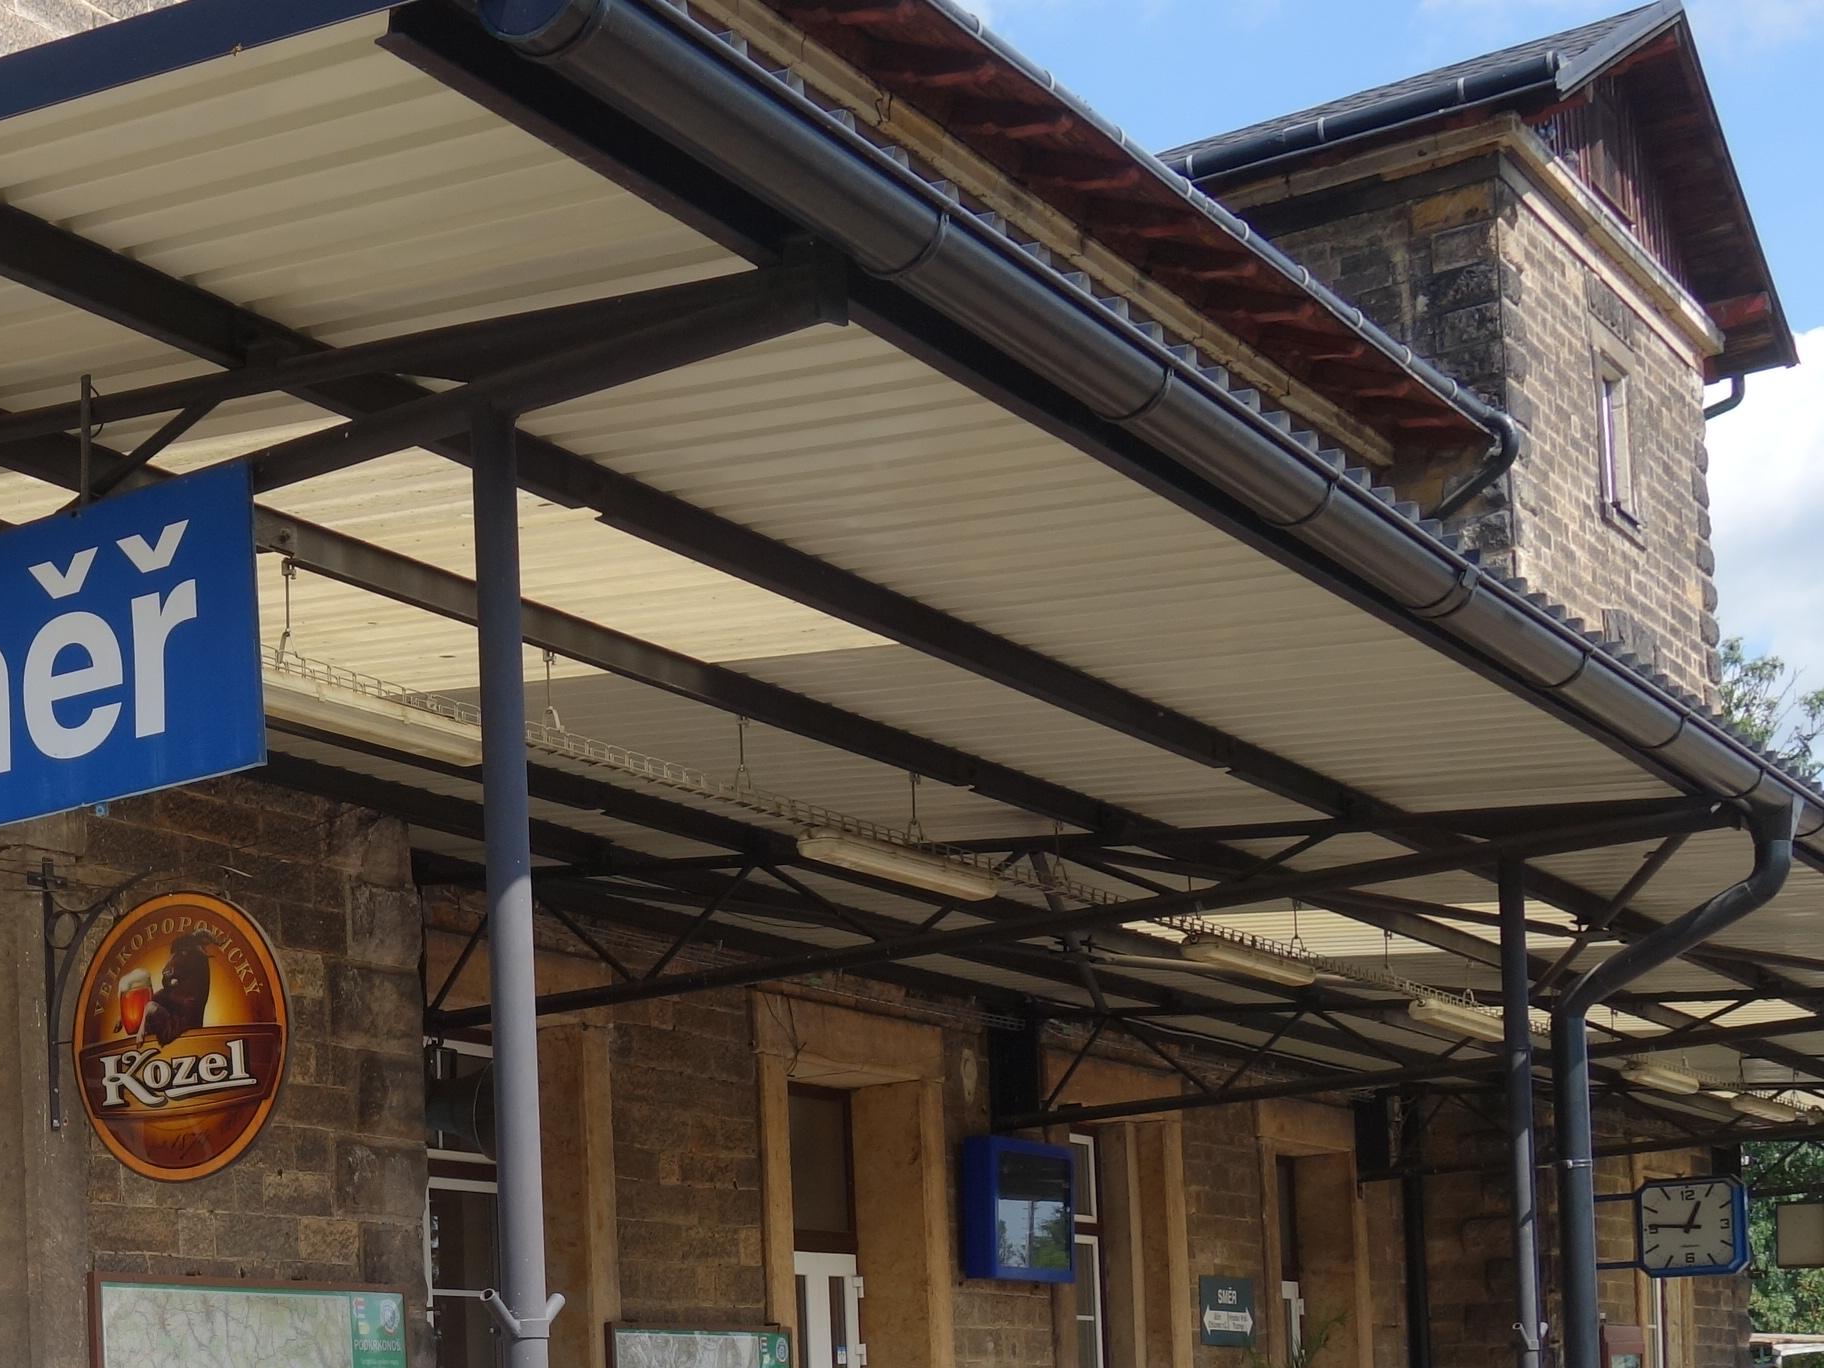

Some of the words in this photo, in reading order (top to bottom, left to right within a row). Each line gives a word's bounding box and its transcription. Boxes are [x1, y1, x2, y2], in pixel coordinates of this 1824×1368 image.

[93, 916, 264, 1016] VELKOPOPOVICKÝ
[98, 1039, 252, 1107] Kozel
[1680, 1190, 1695, 1201] 12
[1720, 1218, 1730, 1229] 3
[1685, 1252, 1695, 1263] 6
[1217, 1286, 1237, 1305] SMĚR
